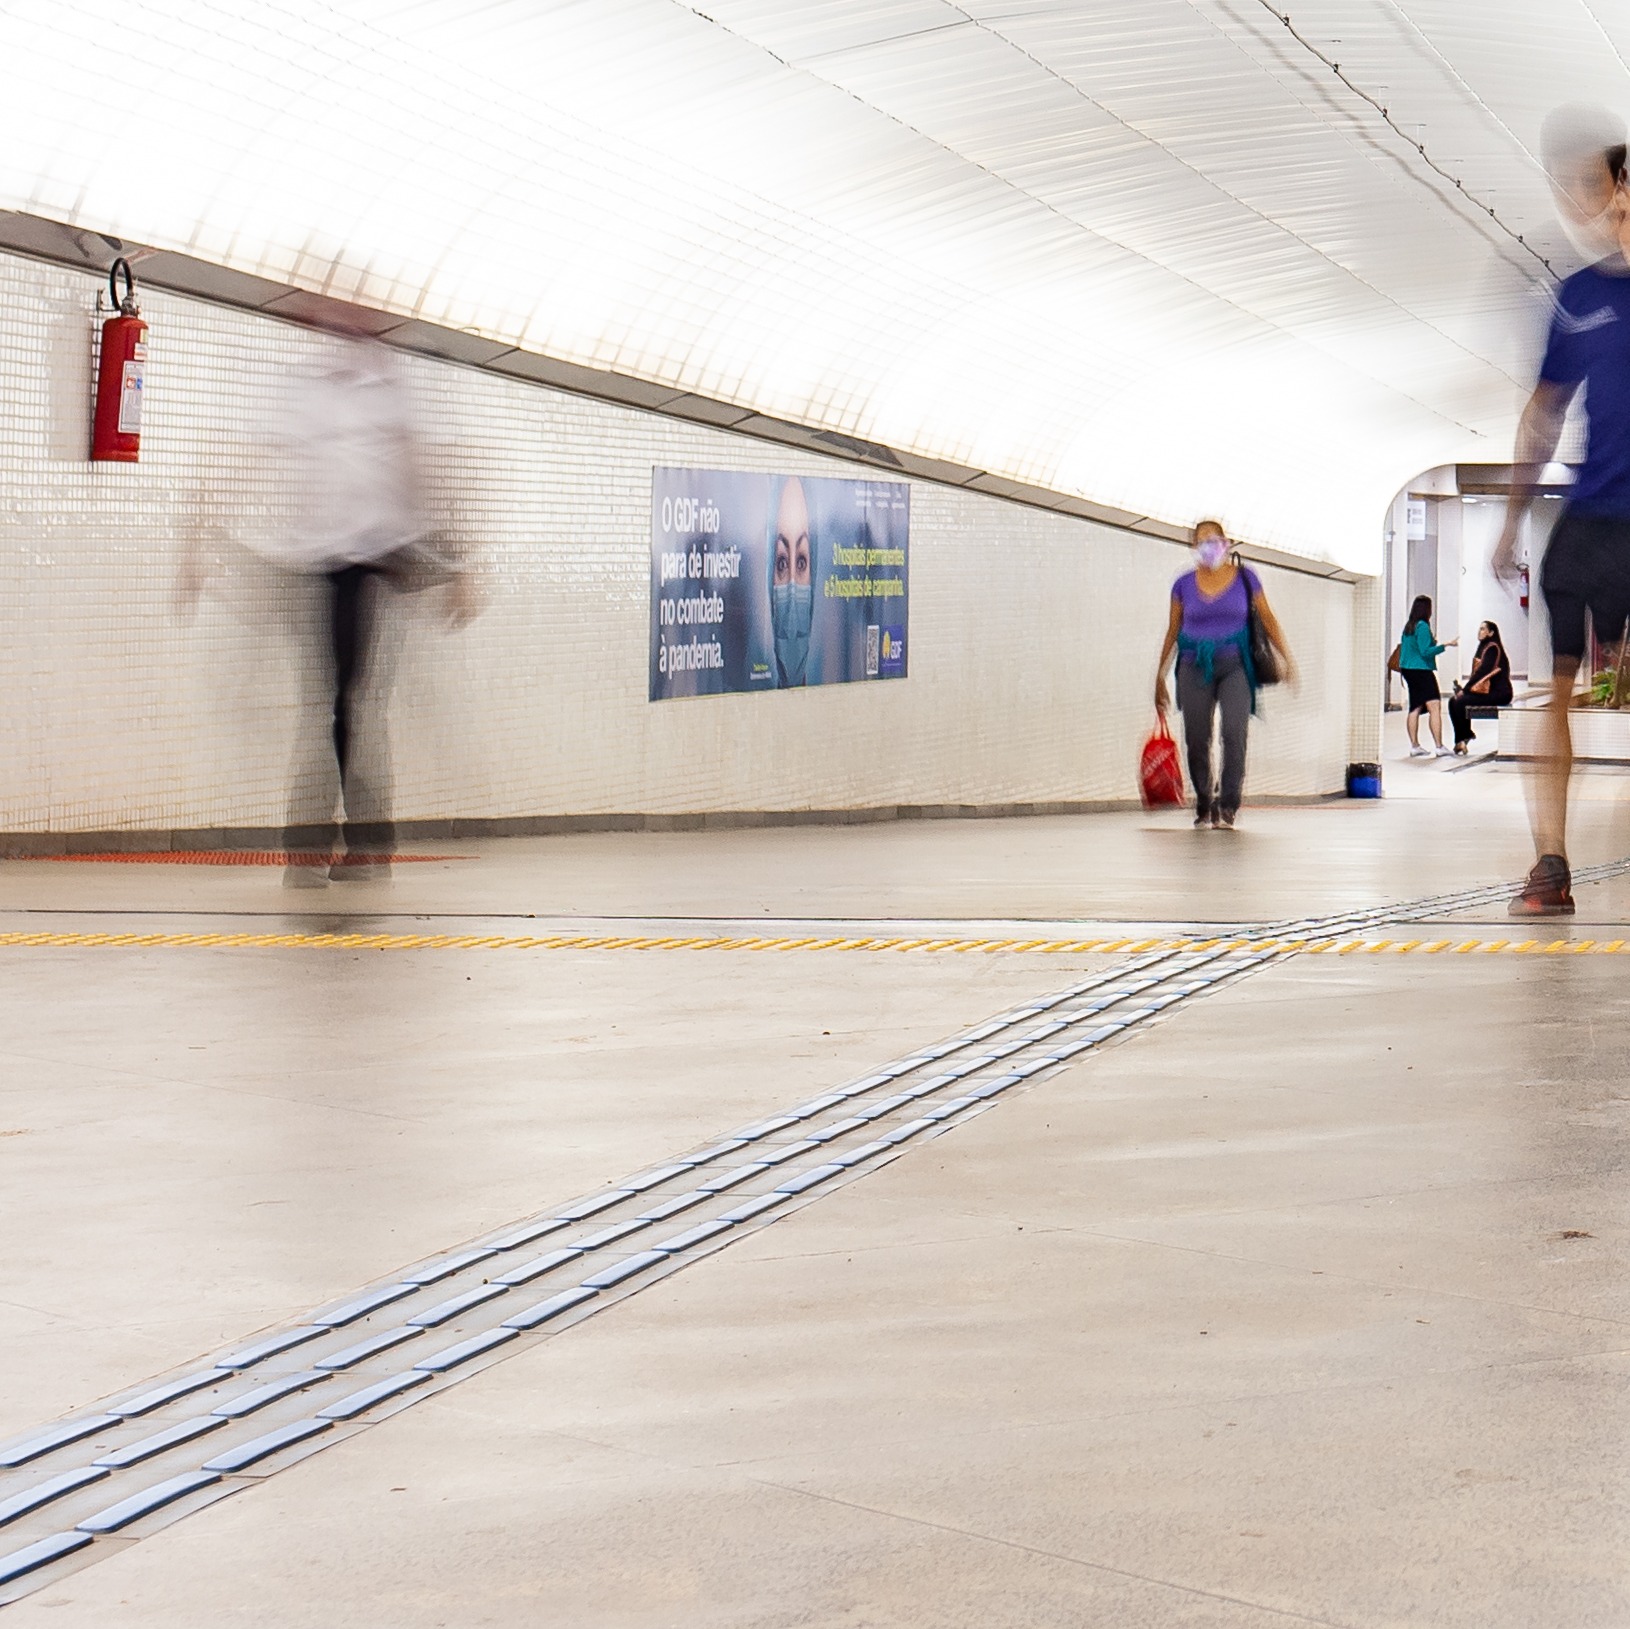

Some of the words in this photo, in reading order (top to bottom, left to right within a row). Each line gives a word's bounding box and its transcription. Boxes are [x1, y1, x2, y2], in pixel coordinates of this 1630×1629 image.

[662, 496, 672, 533] O
[674, 497, 699, 533] GDF
[700, 498, 720, 533] não
[661, 551, 687, 587] para
[688, 543, 702, 579] de
[703, 543, 741, 579] investir
[660, 598, 676, 626] no
[677, 589, 724, 625] combate
[659, 634, 667, 674] à
[668, 633, 724, 680] pandemia.
